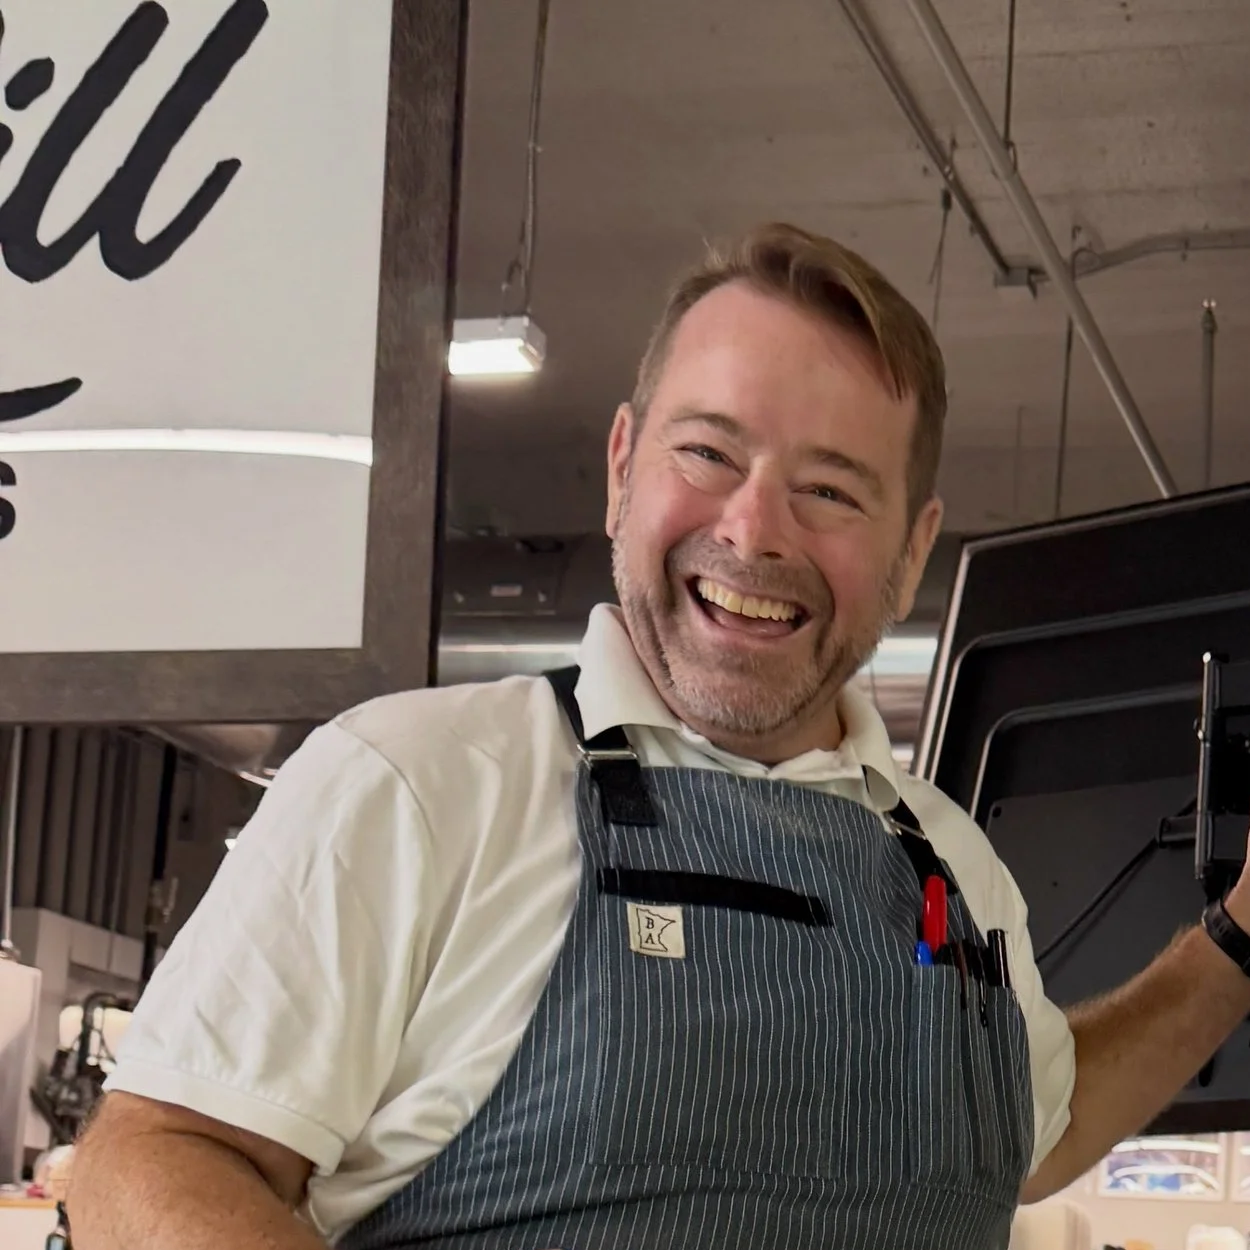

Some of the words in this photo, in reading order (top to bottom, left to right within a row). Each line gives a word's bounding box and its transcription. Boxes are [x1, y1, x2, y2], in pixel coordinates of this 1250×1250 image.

[0, 0, 269, 283] ill
[646, 917, 654, 929] B
[645, 933, 655, 944] A
